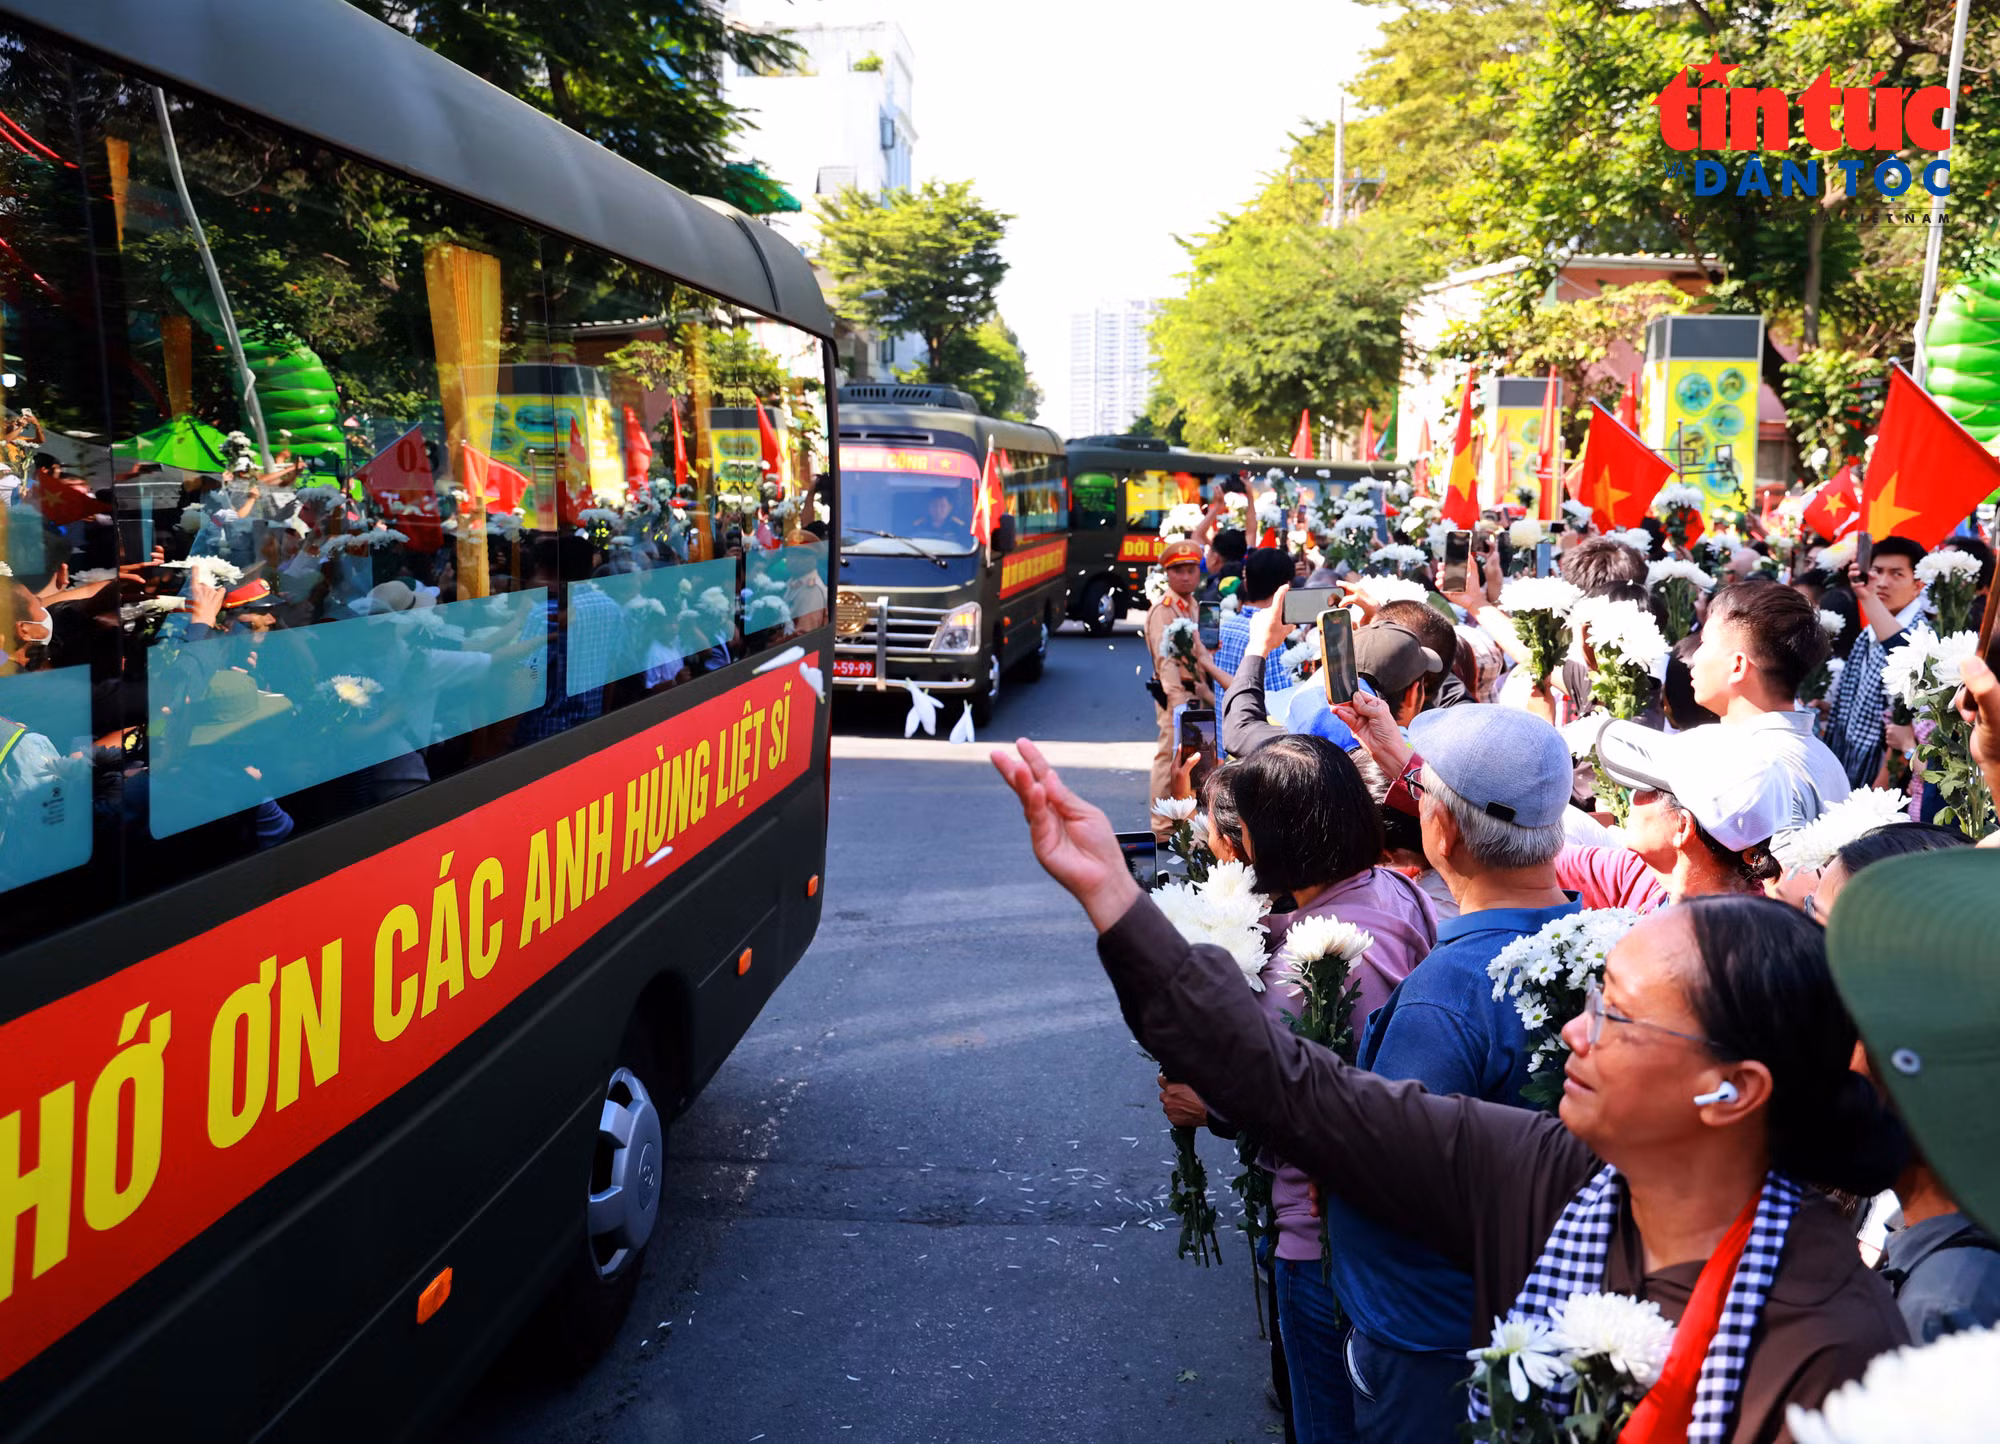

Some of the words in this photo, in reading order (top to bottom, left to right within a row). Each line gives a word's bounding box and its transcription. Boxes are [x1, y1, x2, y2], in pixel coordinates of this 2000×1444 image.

[207, 937, 343, 1149] ƠN
[373, 851, 505, 1043] CÁC
[519, 791, 614, 949] ANH
[623, 739, 711, 873] HÙNG
[715, 699, 766, 808] LIỆT
[768, 680, 793, 769] SĨ
